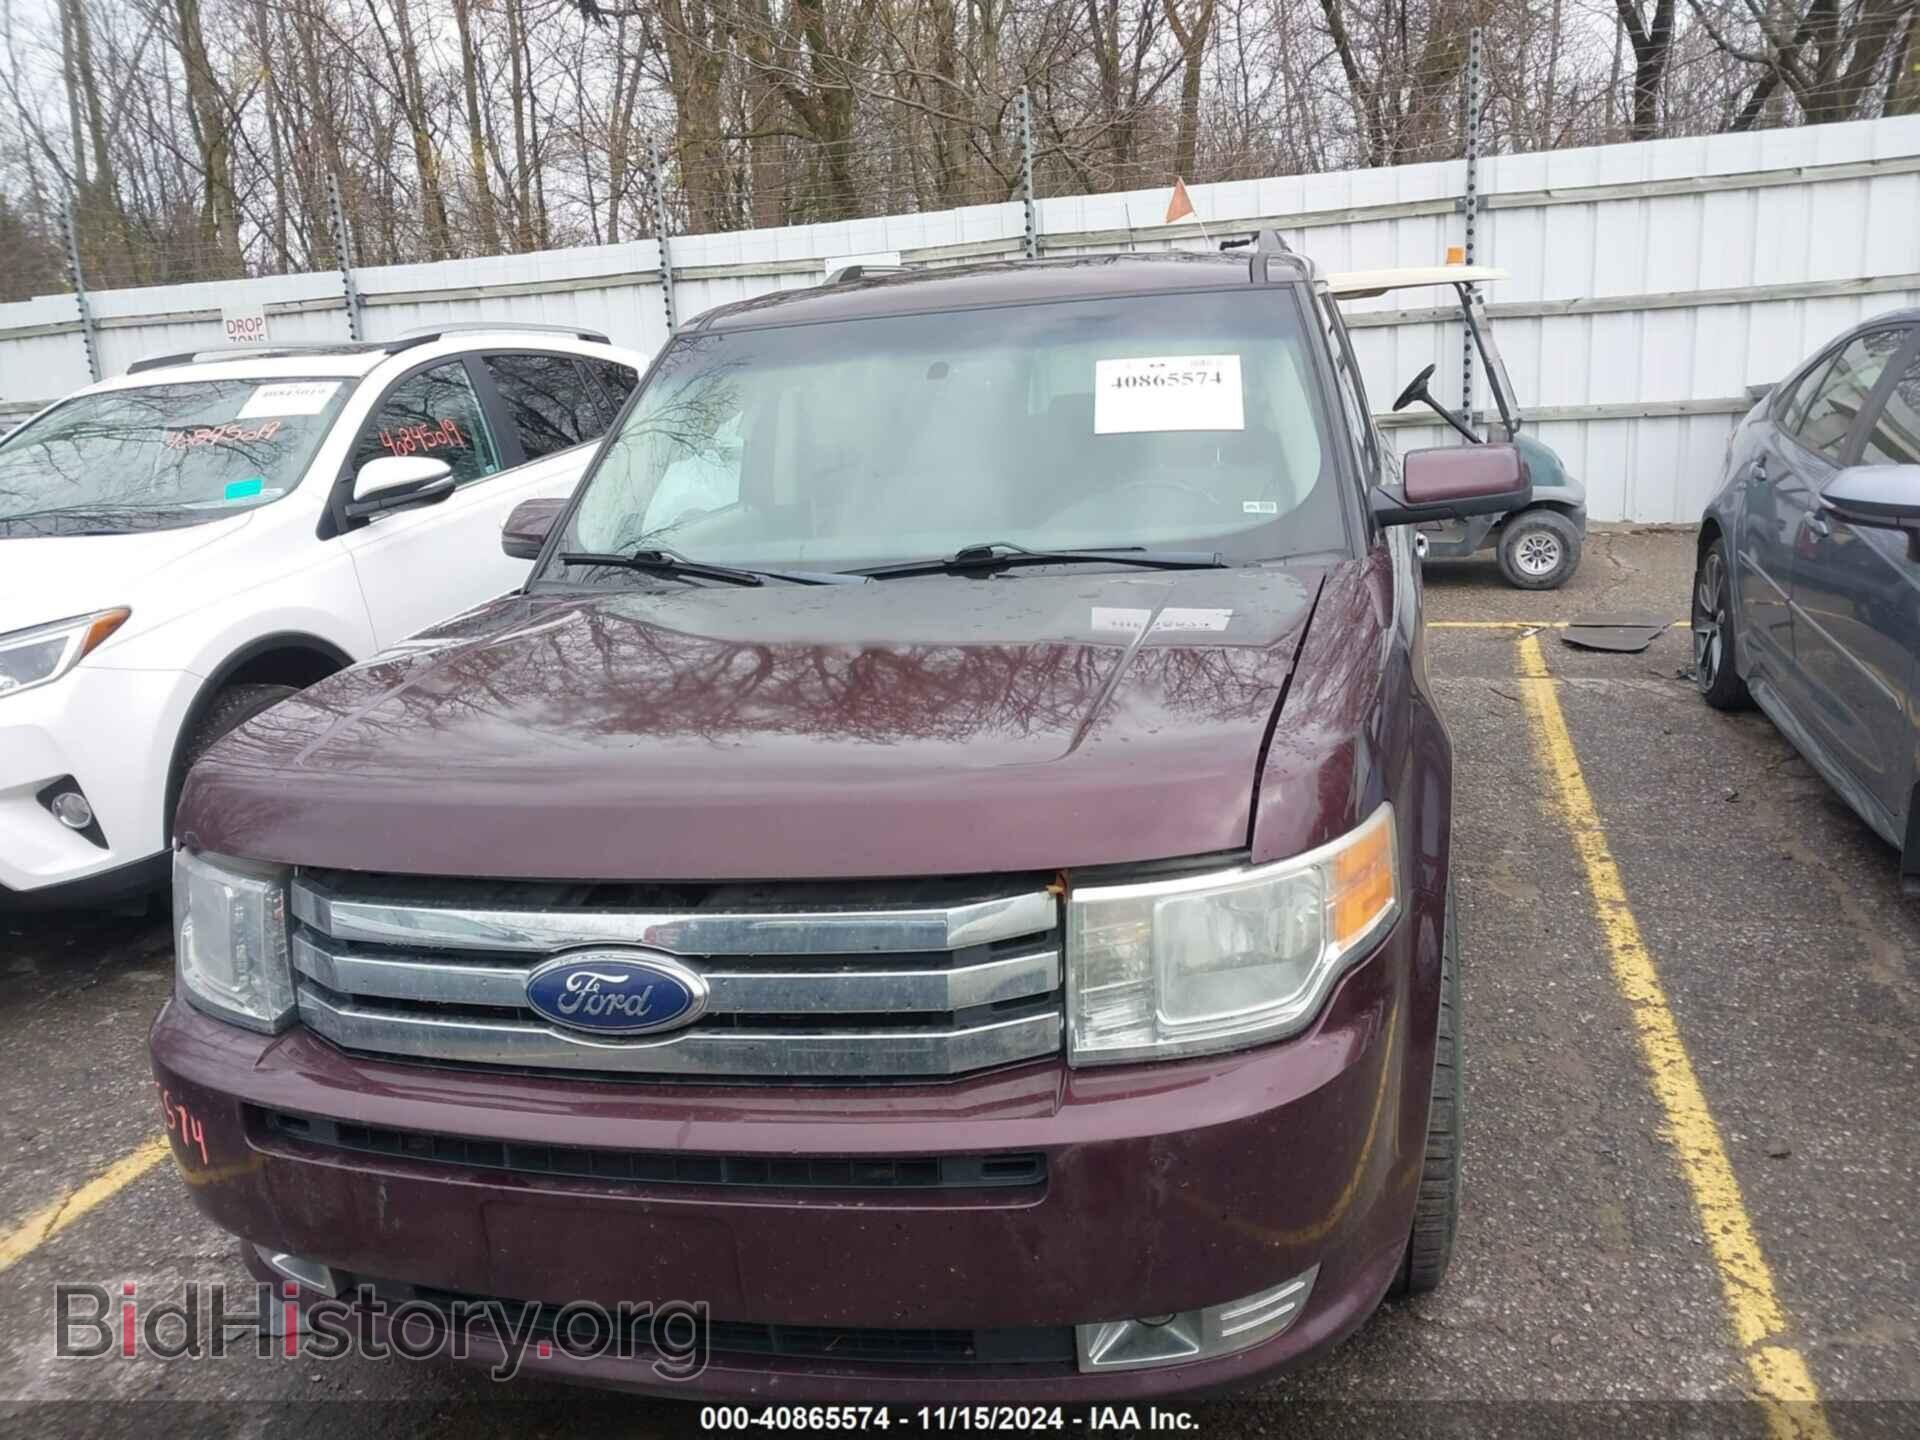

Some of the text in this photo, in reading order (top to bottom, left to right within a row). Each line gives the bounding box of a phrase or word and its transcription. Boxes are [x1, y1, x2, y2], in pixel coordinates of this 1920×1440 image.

[226, 317, 263, 334] DROP
[1111, 370, 1222, 390] 40865574
[379, 419, 465, 457] 40845019
[558, 971, 653, 1016] Ford
